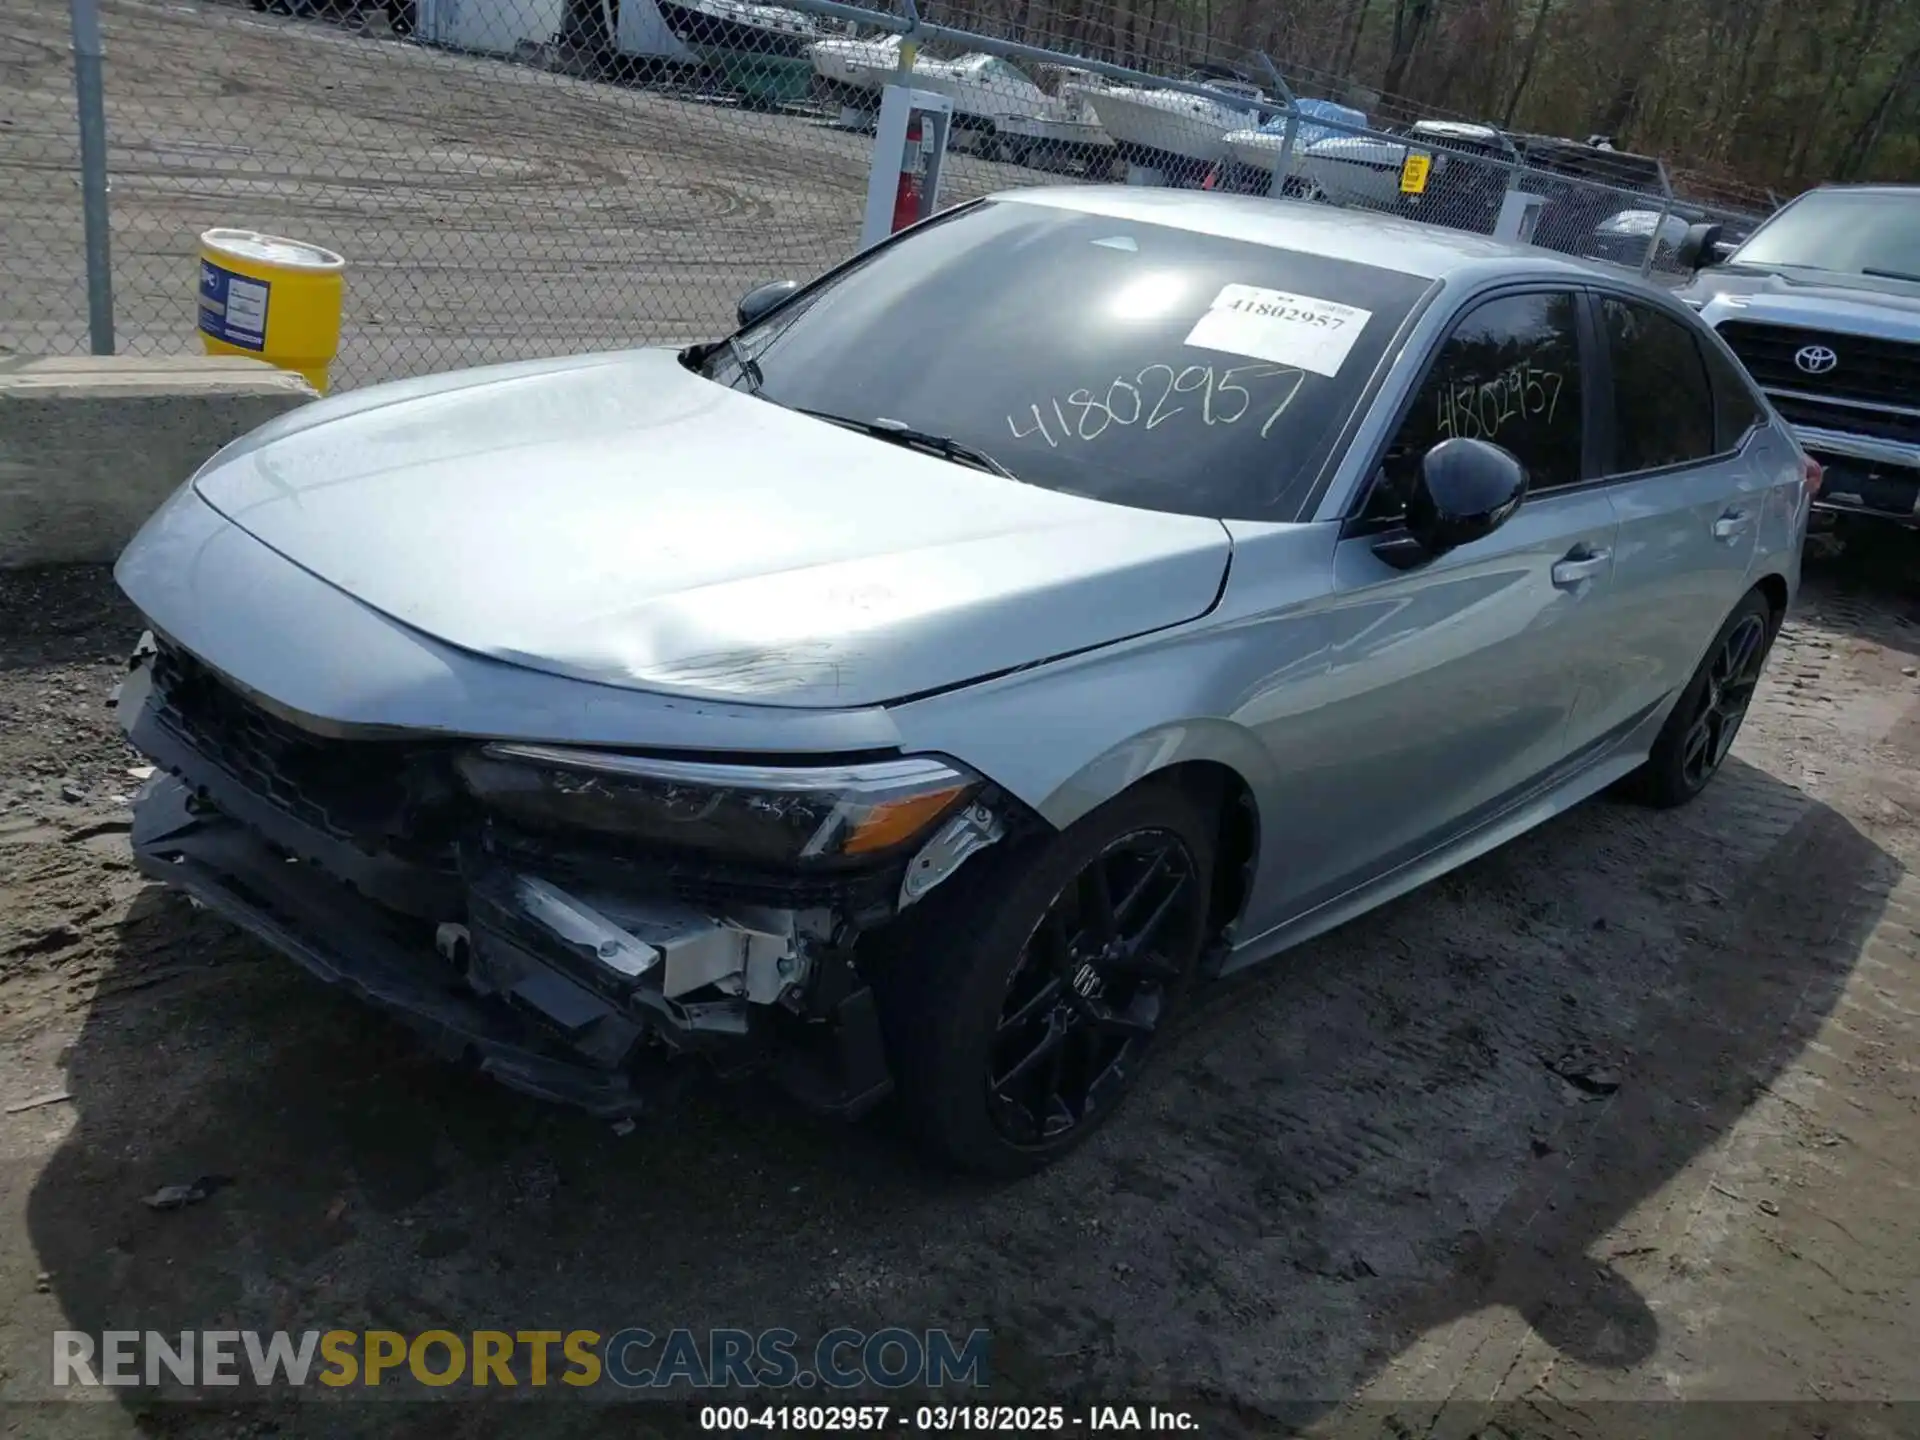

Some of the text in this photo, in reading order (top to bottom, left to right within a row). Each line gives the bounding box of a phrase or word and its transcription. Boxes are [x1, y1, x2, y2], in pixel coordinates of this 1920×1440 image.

[1228, 299, 1345, 330] 41802957
[1007, 364, 1306, 447] 41802957
[1437, 367, 1563, 439] 41802957
